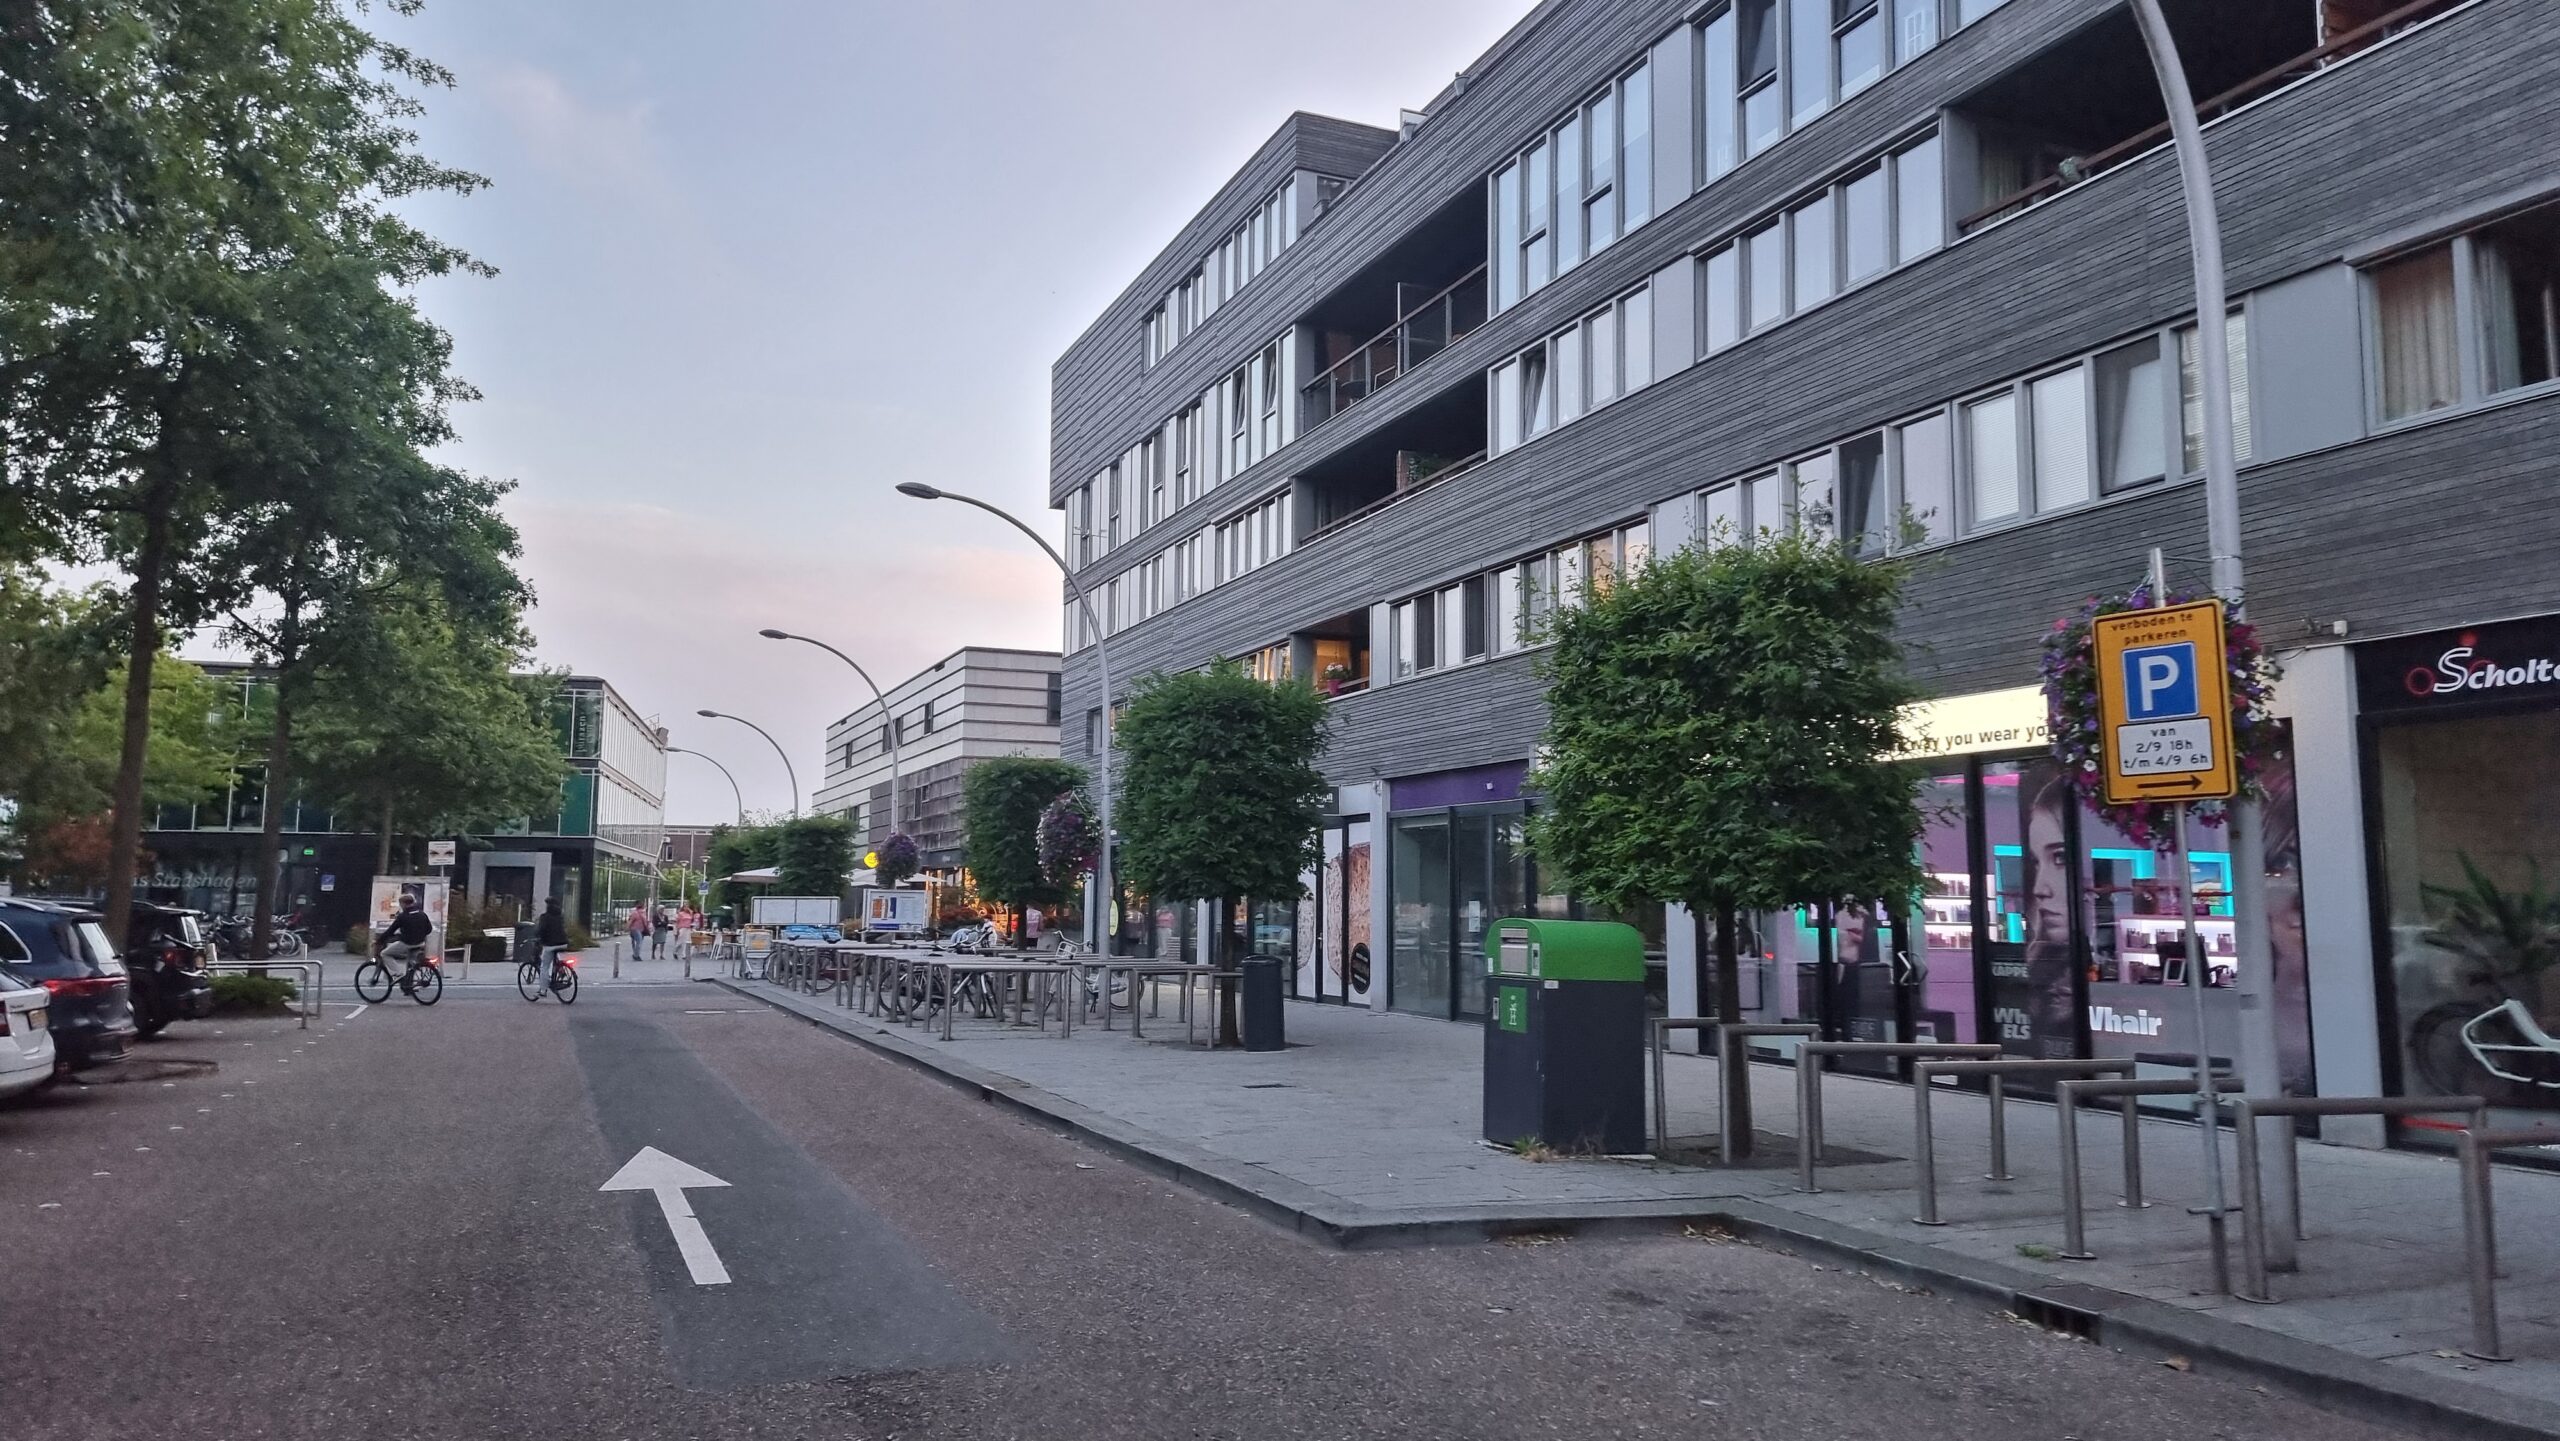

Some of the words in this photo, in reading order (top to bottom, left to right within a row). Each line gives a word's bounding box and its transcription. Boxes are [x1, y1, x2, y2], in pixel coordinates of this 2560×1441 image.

[2111, 615, 2176, 631] verboden
[2180, 613, 2193, 622] te
[2124, 629, 2187, 646] parkeren
[2139, 655, 2179, 711] P
[1945, 734, 1973, 750] you
[1979, 729, 2020, 743] wear
[2026, 725, 2048, 742] yo
[2151, 728, 2176, 737] van
[2135, 741, 2162, 753] 2/9
[2170, 740, 2193, 750] 18h
[2123, 757, 2150, 768] t/m
[2155, 755, 2182, 766] 4/9
[2190, 754, 2208, 764] 6h
